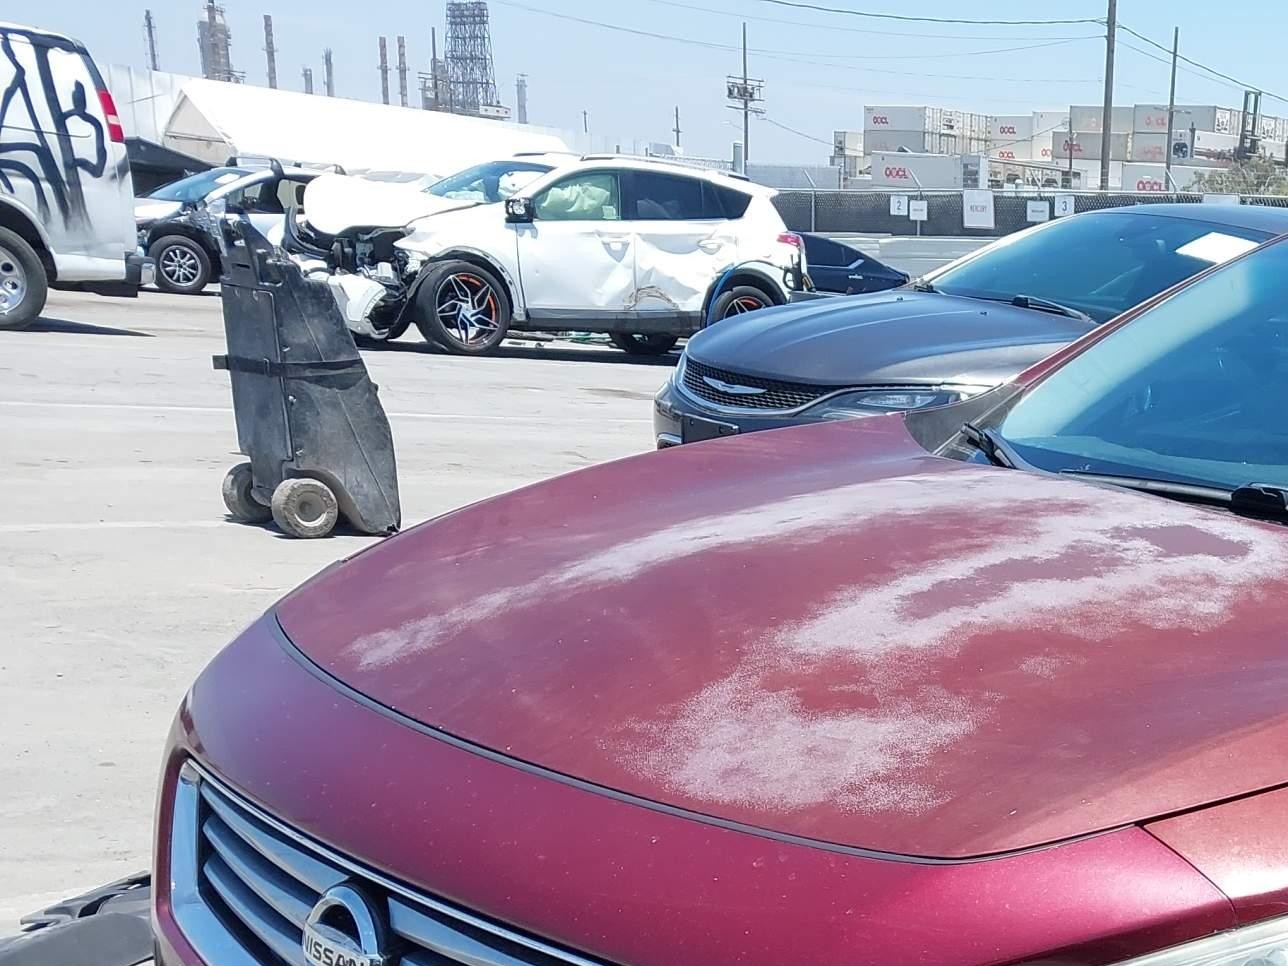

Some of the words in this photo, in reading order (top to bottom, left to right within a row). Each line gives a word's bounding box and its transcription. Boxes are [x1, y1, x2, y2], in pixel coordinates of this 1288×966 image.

[1000, 126, 1016, 135] OOCL
[885, 167, 909, 179] OOCL
[896, 200, 902, 210] 2
[1062, 200, 1068, 211] 3
